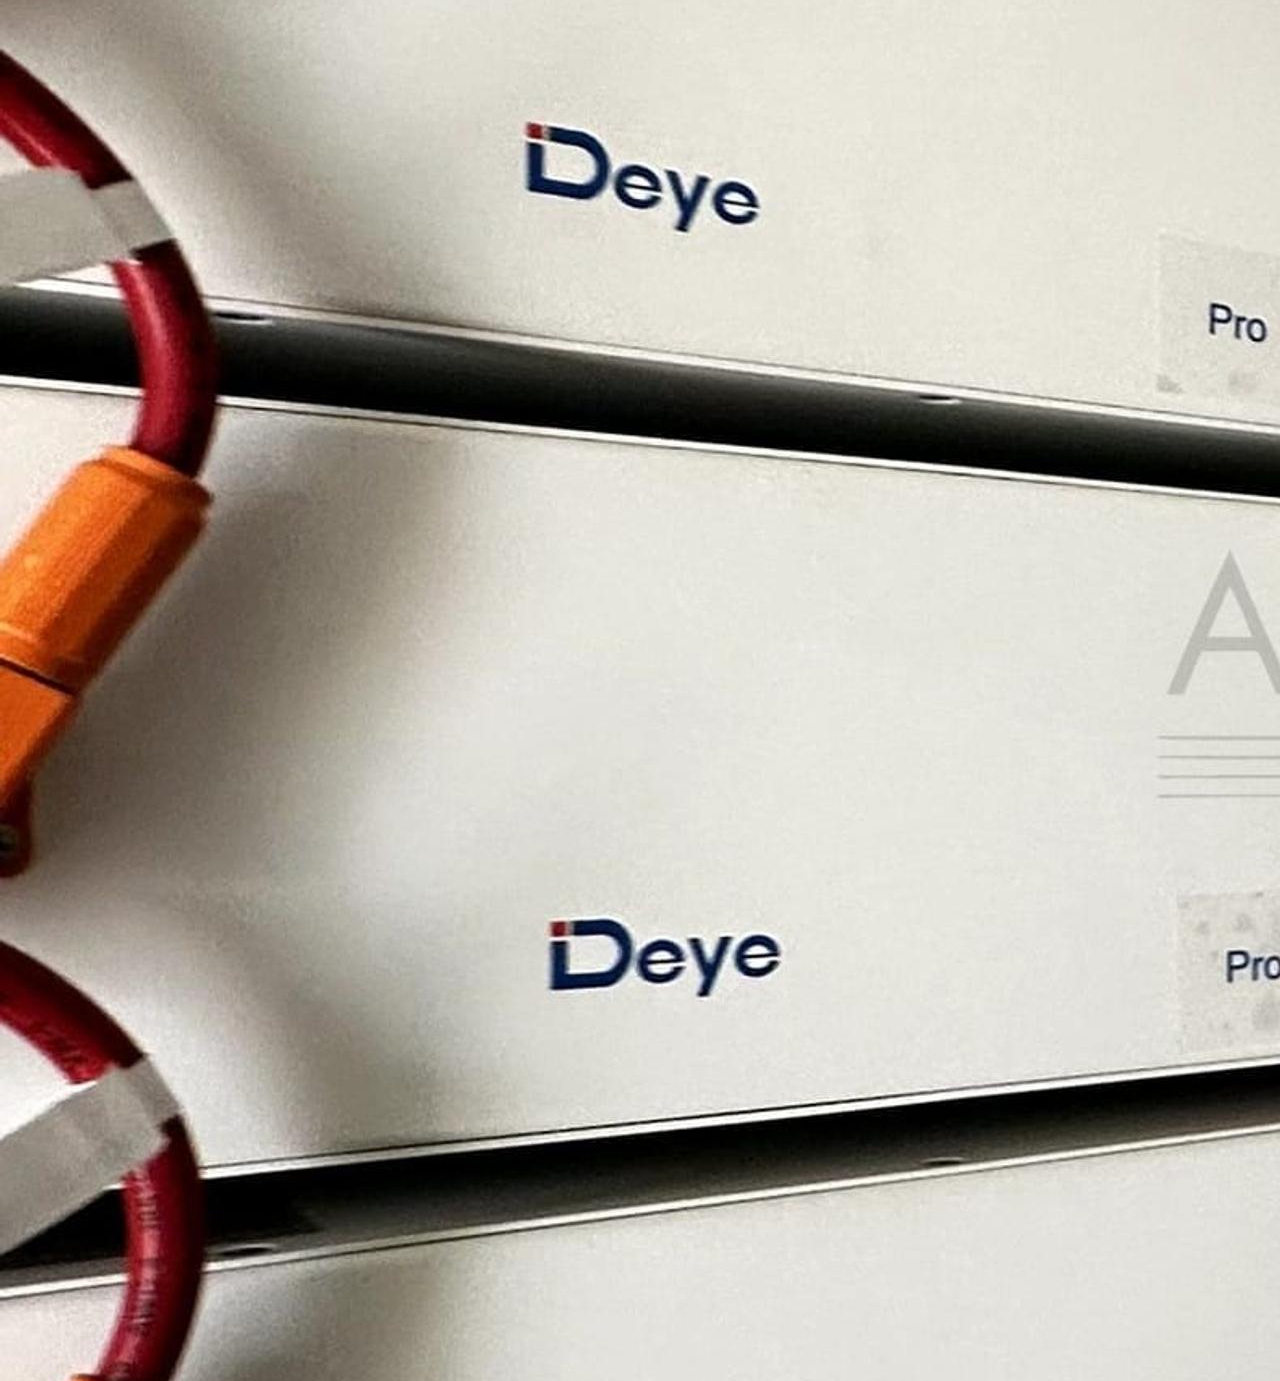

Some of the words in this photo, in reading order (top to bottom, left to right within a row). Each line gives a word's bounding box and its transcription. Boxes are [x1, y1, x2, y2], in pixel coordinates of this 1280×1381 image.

[525, 121, 760, 233] Deye
[1208, 302, 1268, 344] Pro
[548, 918, 781, 996] Deye
